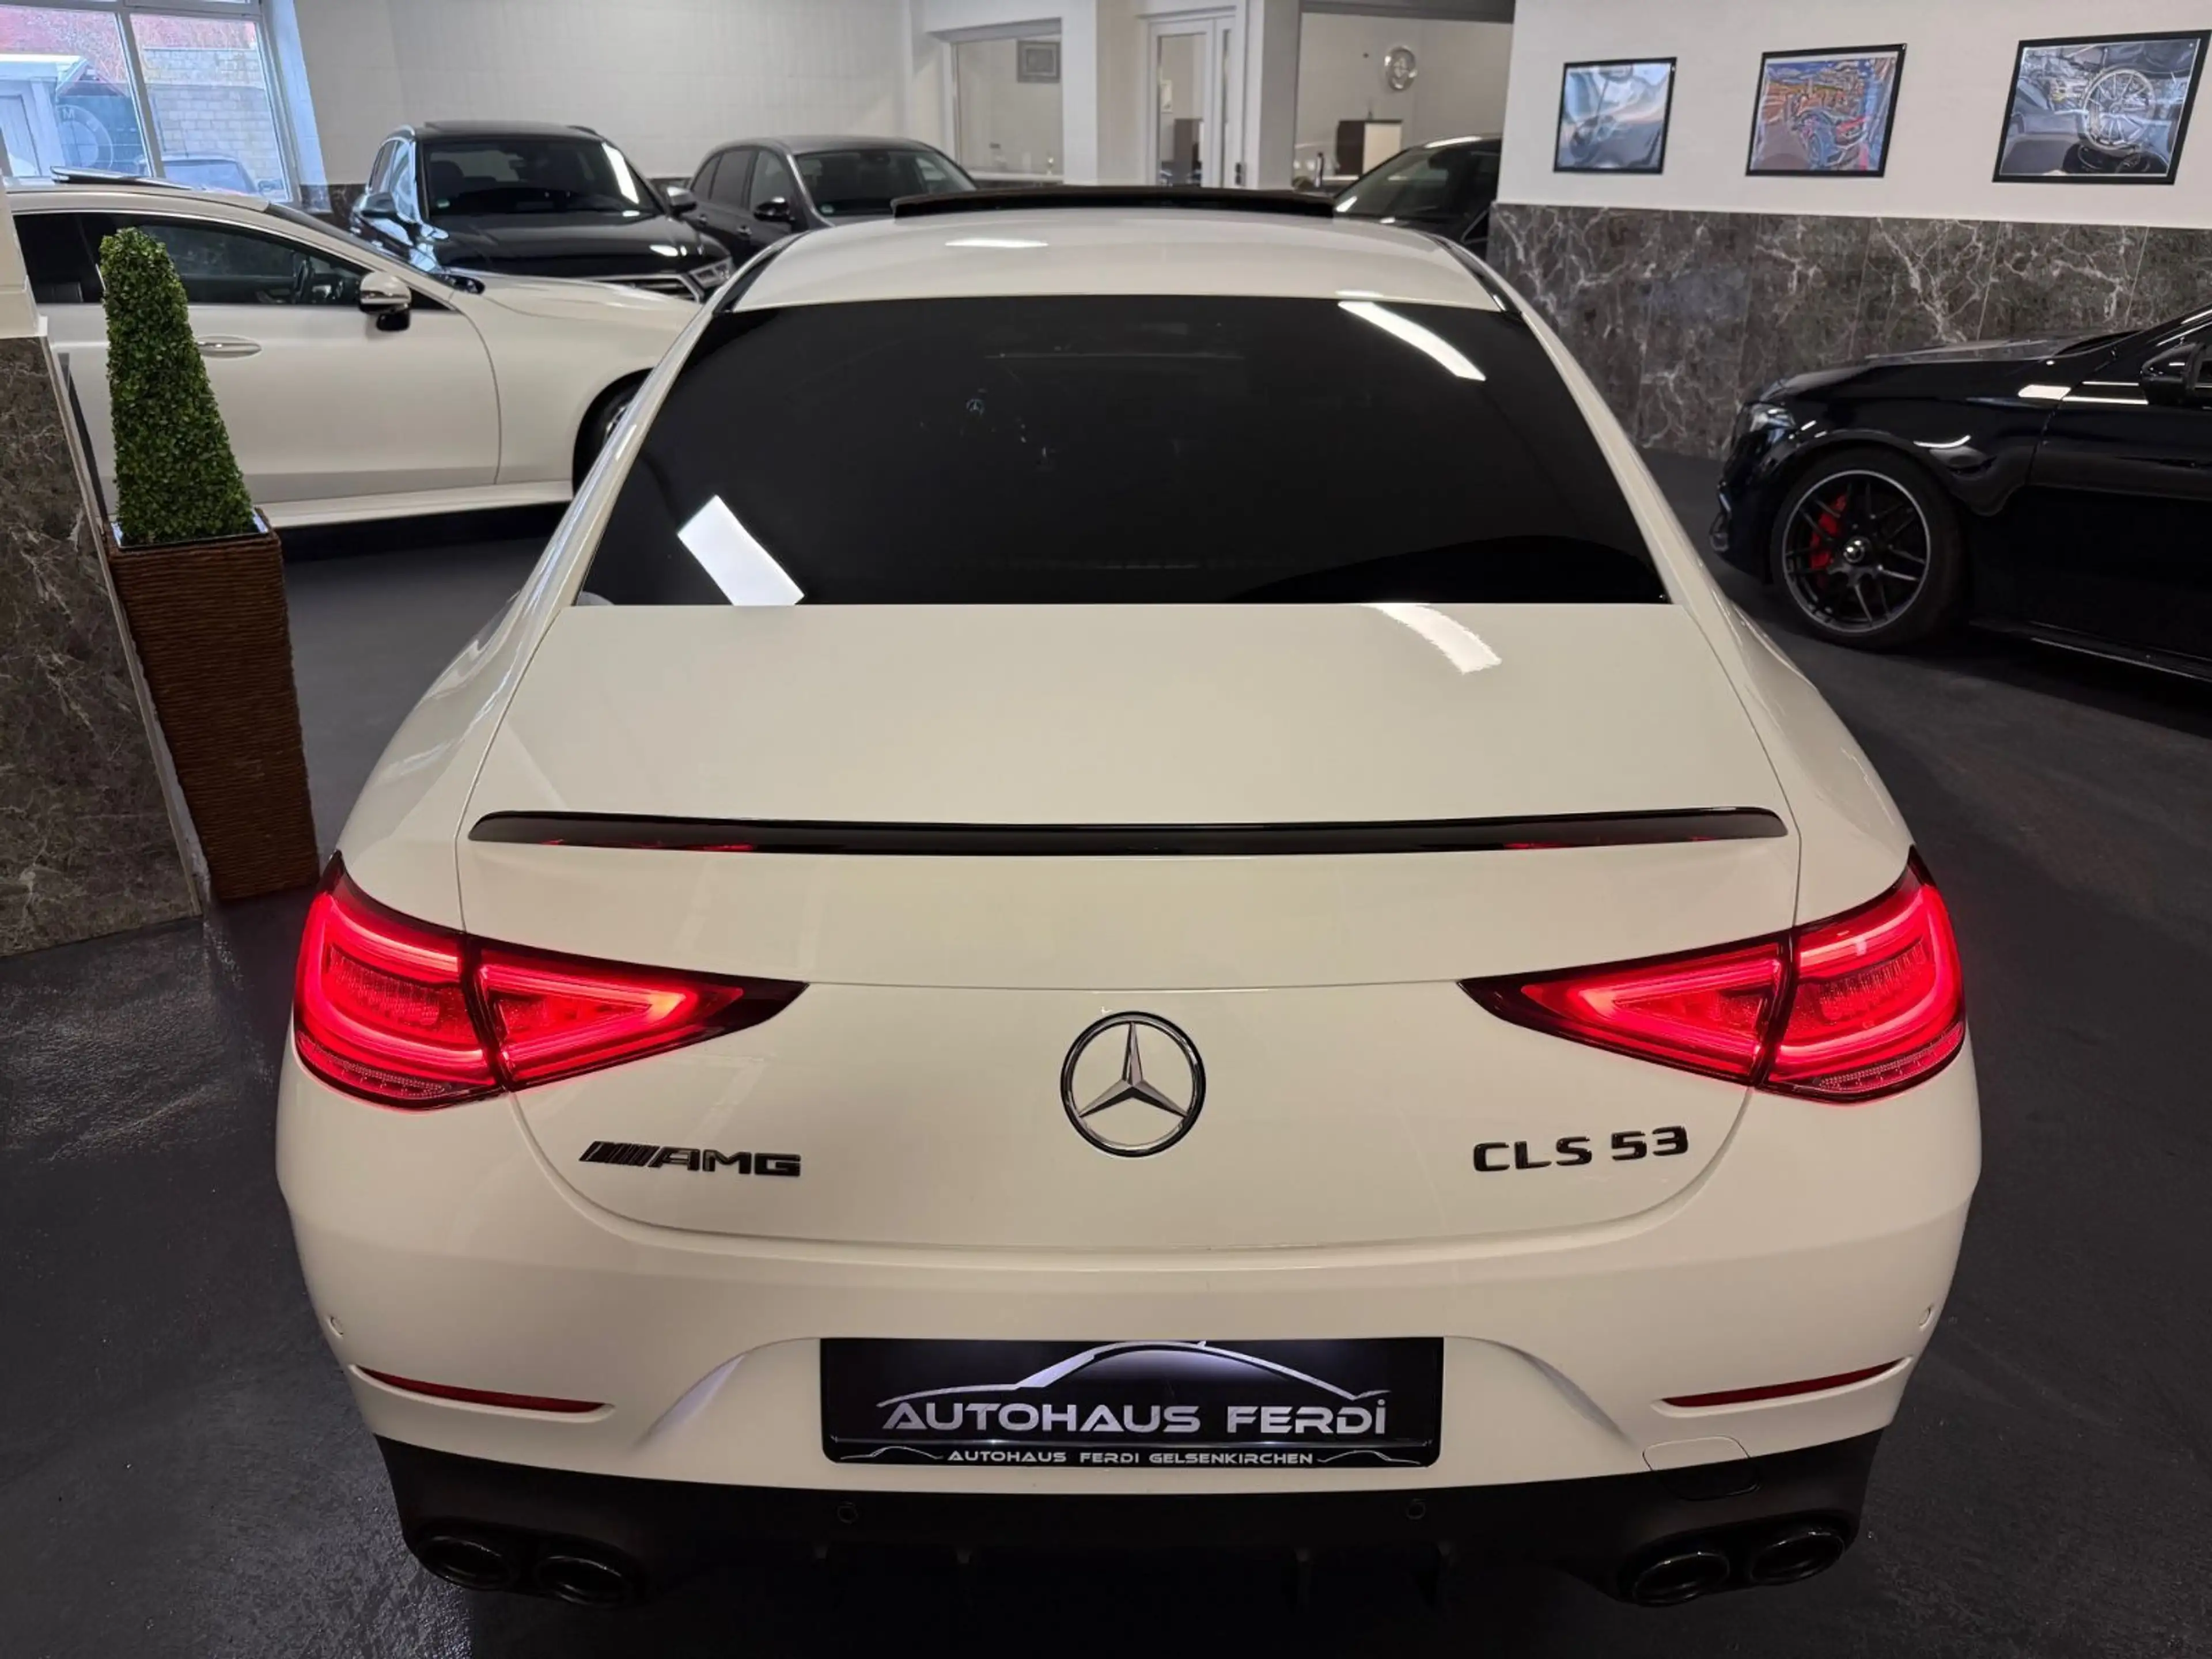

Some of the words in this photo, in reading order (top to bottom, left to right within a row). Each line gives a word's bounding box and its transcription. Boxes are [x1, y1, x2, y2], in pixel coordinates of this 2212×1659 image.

[647, 1146, 801, 1177] AMG
[1473, 1137, 1592, 1172] CLS
[1611, 1126, 1689, 1161] 53
[882, 1402, 1200, 1433] AUTOHAUS
[948, 1450, 1067, 1463] AUTOHAUS
[1080, 1452, 1139, 1464] FERDI
[1149, 1453, 1313, 1464] GELSENKIRCHEN
